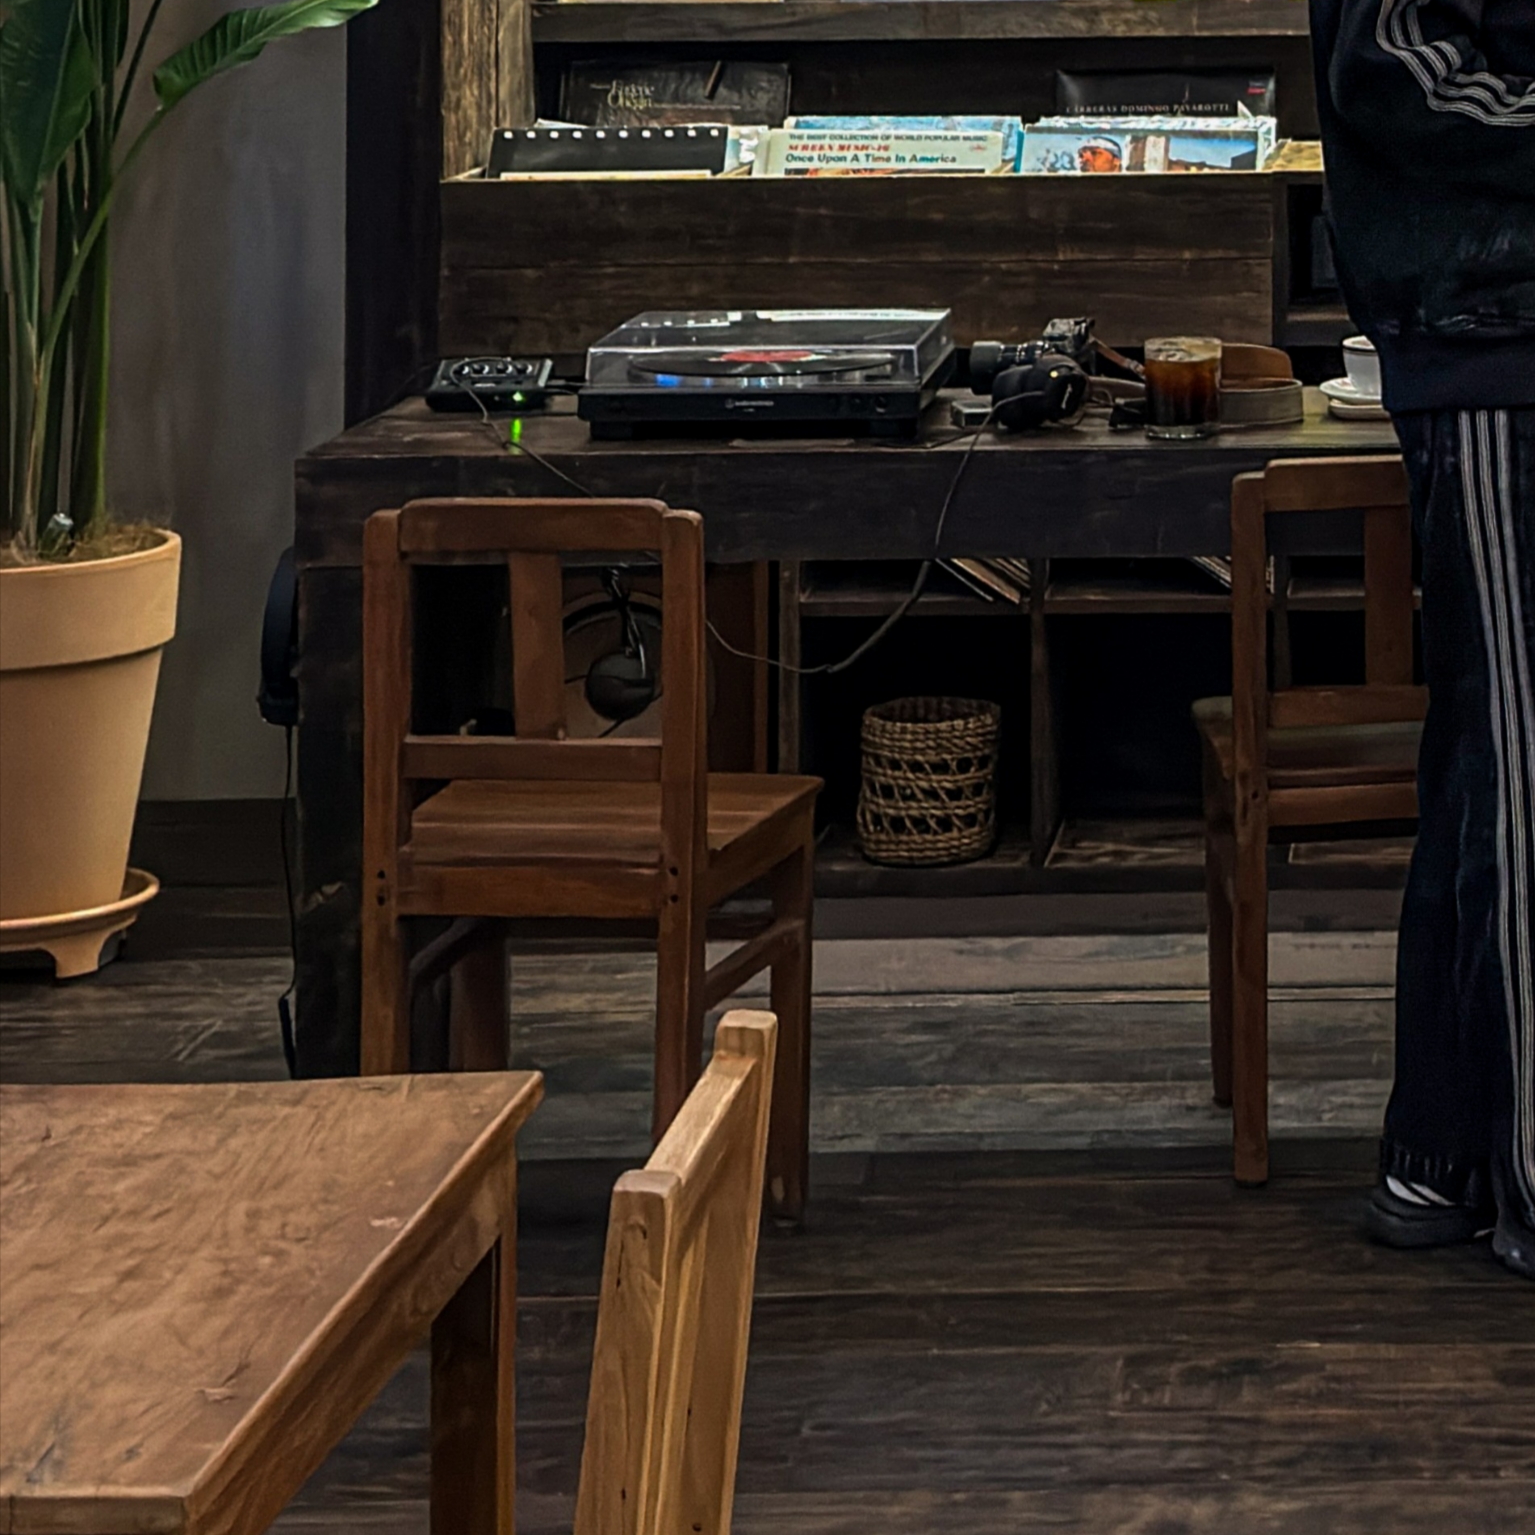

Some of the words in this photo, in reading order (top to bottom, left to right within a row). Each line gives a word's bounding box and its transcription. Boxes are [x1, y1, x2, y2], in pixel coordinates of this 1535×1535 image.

[789, 133, 804, 141] THE
[806, 133, 827, 141] BEST
[924, 134, 960, 142] POPULAR
[785, 153, 814, 163] Once
[817, 153, 847, 165] Upon
[850, 154, 860, 163] A
[864, 153, 892, 163] Time
[895, 153, 906, 163] In
[909, 153, 957, 163] America
